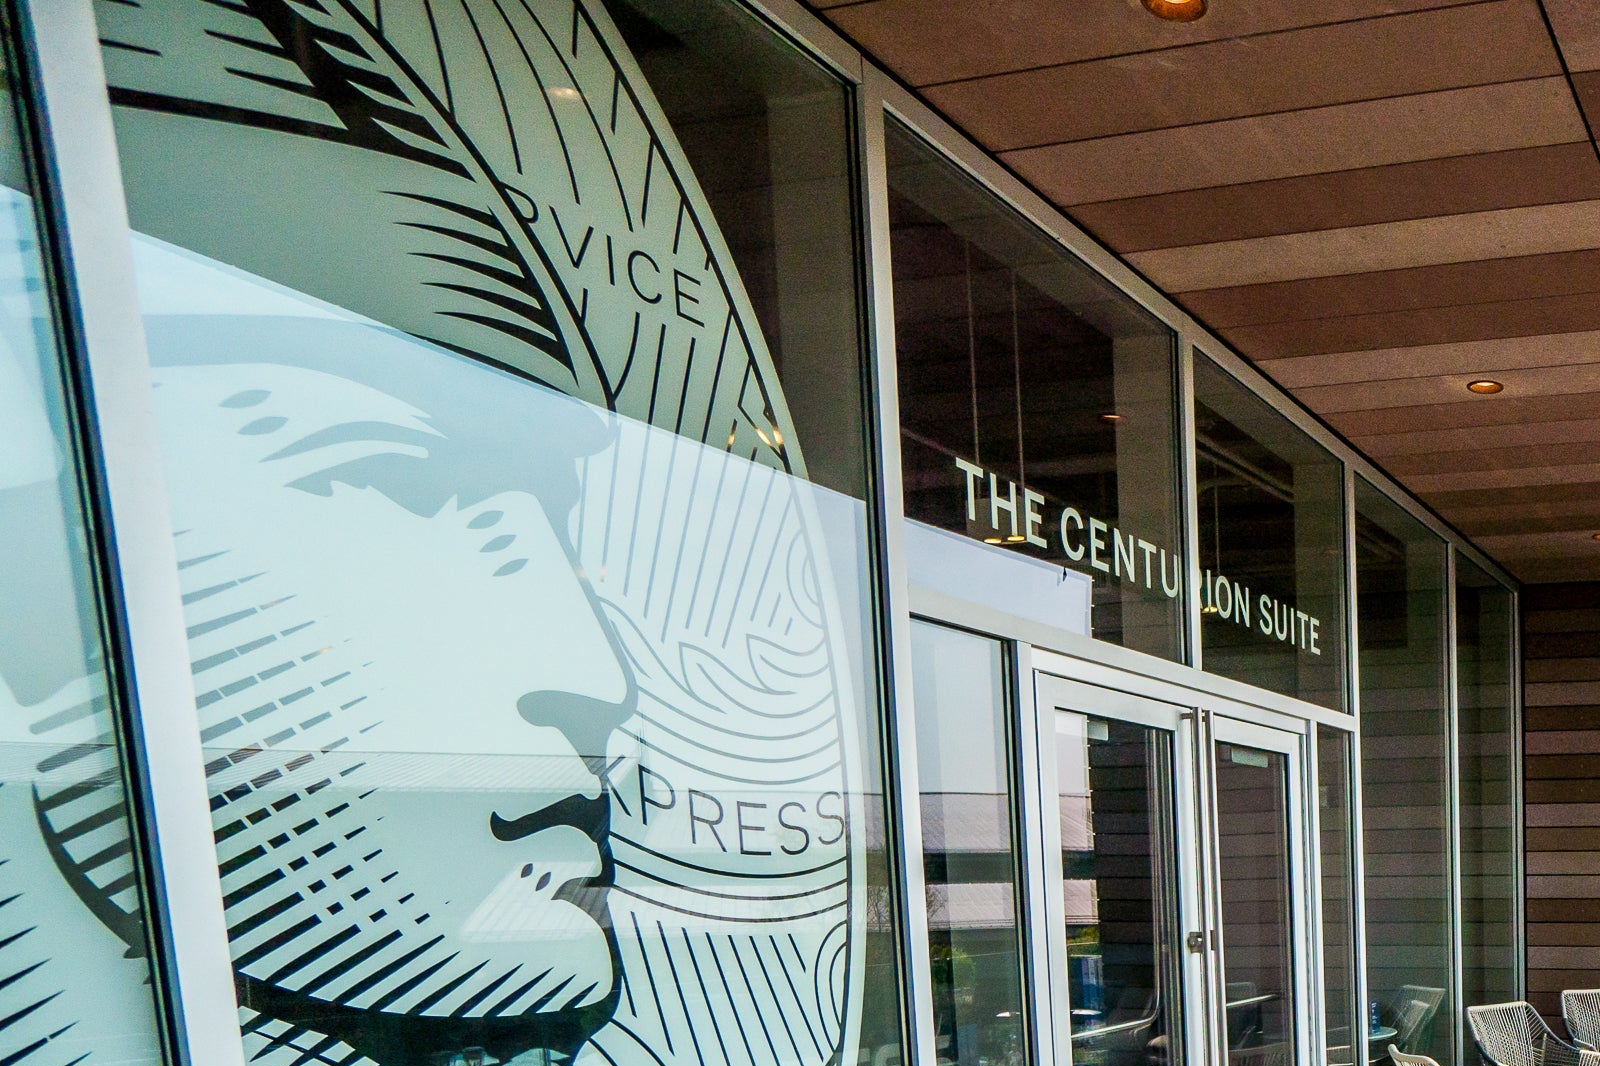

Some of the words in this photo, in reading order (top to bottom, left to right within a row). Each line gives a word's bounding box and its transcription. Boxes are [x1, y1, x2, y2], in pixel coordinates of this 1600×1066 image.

[955, 456, 1048, 550] THE
[1060, 506, 1251, 629] CENTUION
[1259, 593, 1321, 656] SUITE
